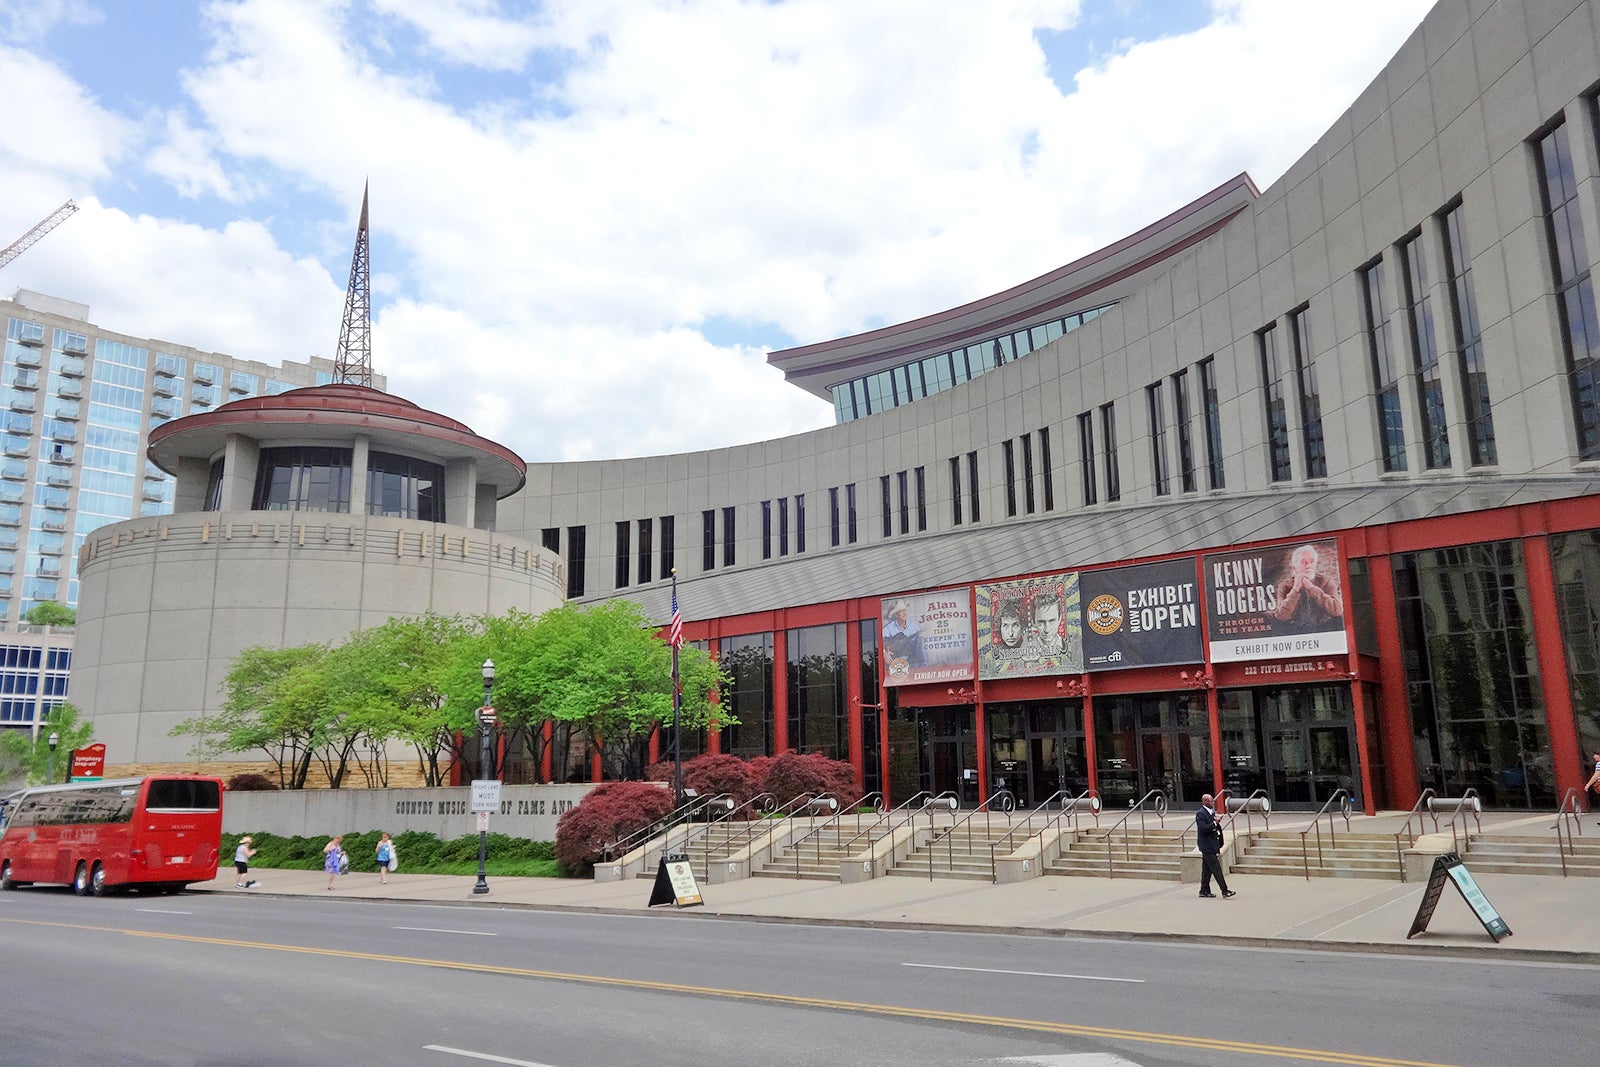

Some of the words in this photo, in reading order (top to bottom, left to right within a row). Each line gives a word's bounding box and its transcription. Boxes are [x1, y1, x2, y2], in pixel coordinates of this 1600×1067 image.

[1213, 557, 1263, 588] KENNY
[1127, 583, 1193, 609] EXHIBIT
[1215, 584, 1277, 616] ROGERS
[927, 601, 957, 612] Alan
[918, 610, 968, 625] Jackson
[936, 619, 949, 629] 25
[1129, 610, 1140, 633] NOW
[1140, 603, 1196, 631] OPEN
[1218, 617, 1265, 627] THROUGH
[1218, 627, 1238, 635] THE
[1241, 624, 1272, 633] YEARS
[923, 640, 967, 650] COUNTRY
[1235, 643, 1269, 655] EXHIBIT
[1272, 642, 1292, 652] NOW
[1296, 639, 1320, 650] OPEN
[1108, 651, 1122, 662] citi
[914, 671, 936, 681] EXHIBIT
[937, 670, 951, 679] NOW
[952, 668, 968, 678] OPEN
[1244, 667, 1257, 675] 222
[1260, 664, 1282, 674] FIFTH
[1284, 661, 1316, 673] AVENUE,
[1317, 661, 1325, 670] S.
[396, 800, 433, 815] COUNTRY
[438, 800, 466, 815] MUSIC
[501, 800, 513, 815] OF
[518, 800, 545, 815] FAME
[551, 800, 573, 815] AND
